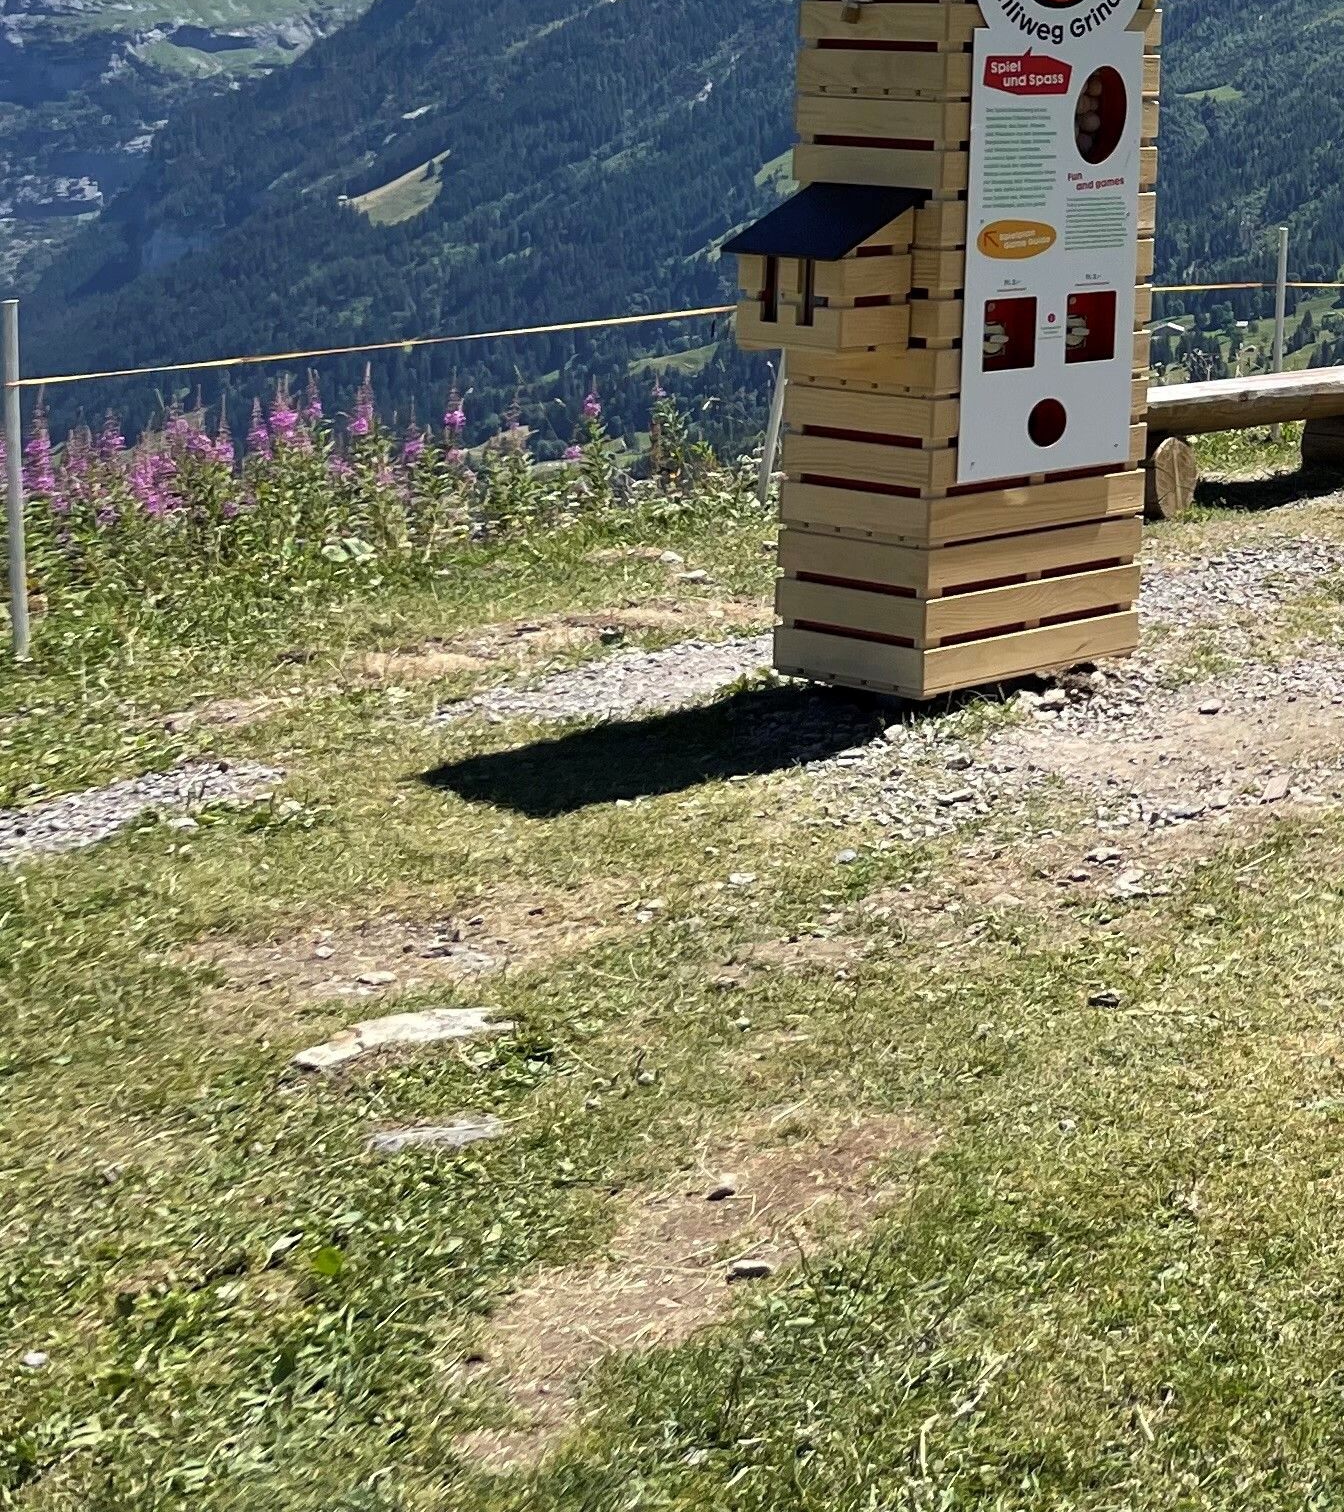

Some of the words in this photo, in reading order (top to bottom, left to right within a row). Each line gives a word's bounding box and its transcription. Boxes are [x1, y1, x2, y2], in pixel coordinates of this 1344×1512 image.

[991, 61, 1021, 74] Spiel
[1003, 74, 1026, 87] und
[1029, 73, 1064, 86] Spass
[1067, 172, 1082, 182] Fun
[1076, 179, 1094, 190] and
[1095, 177, 1125, 189] games
